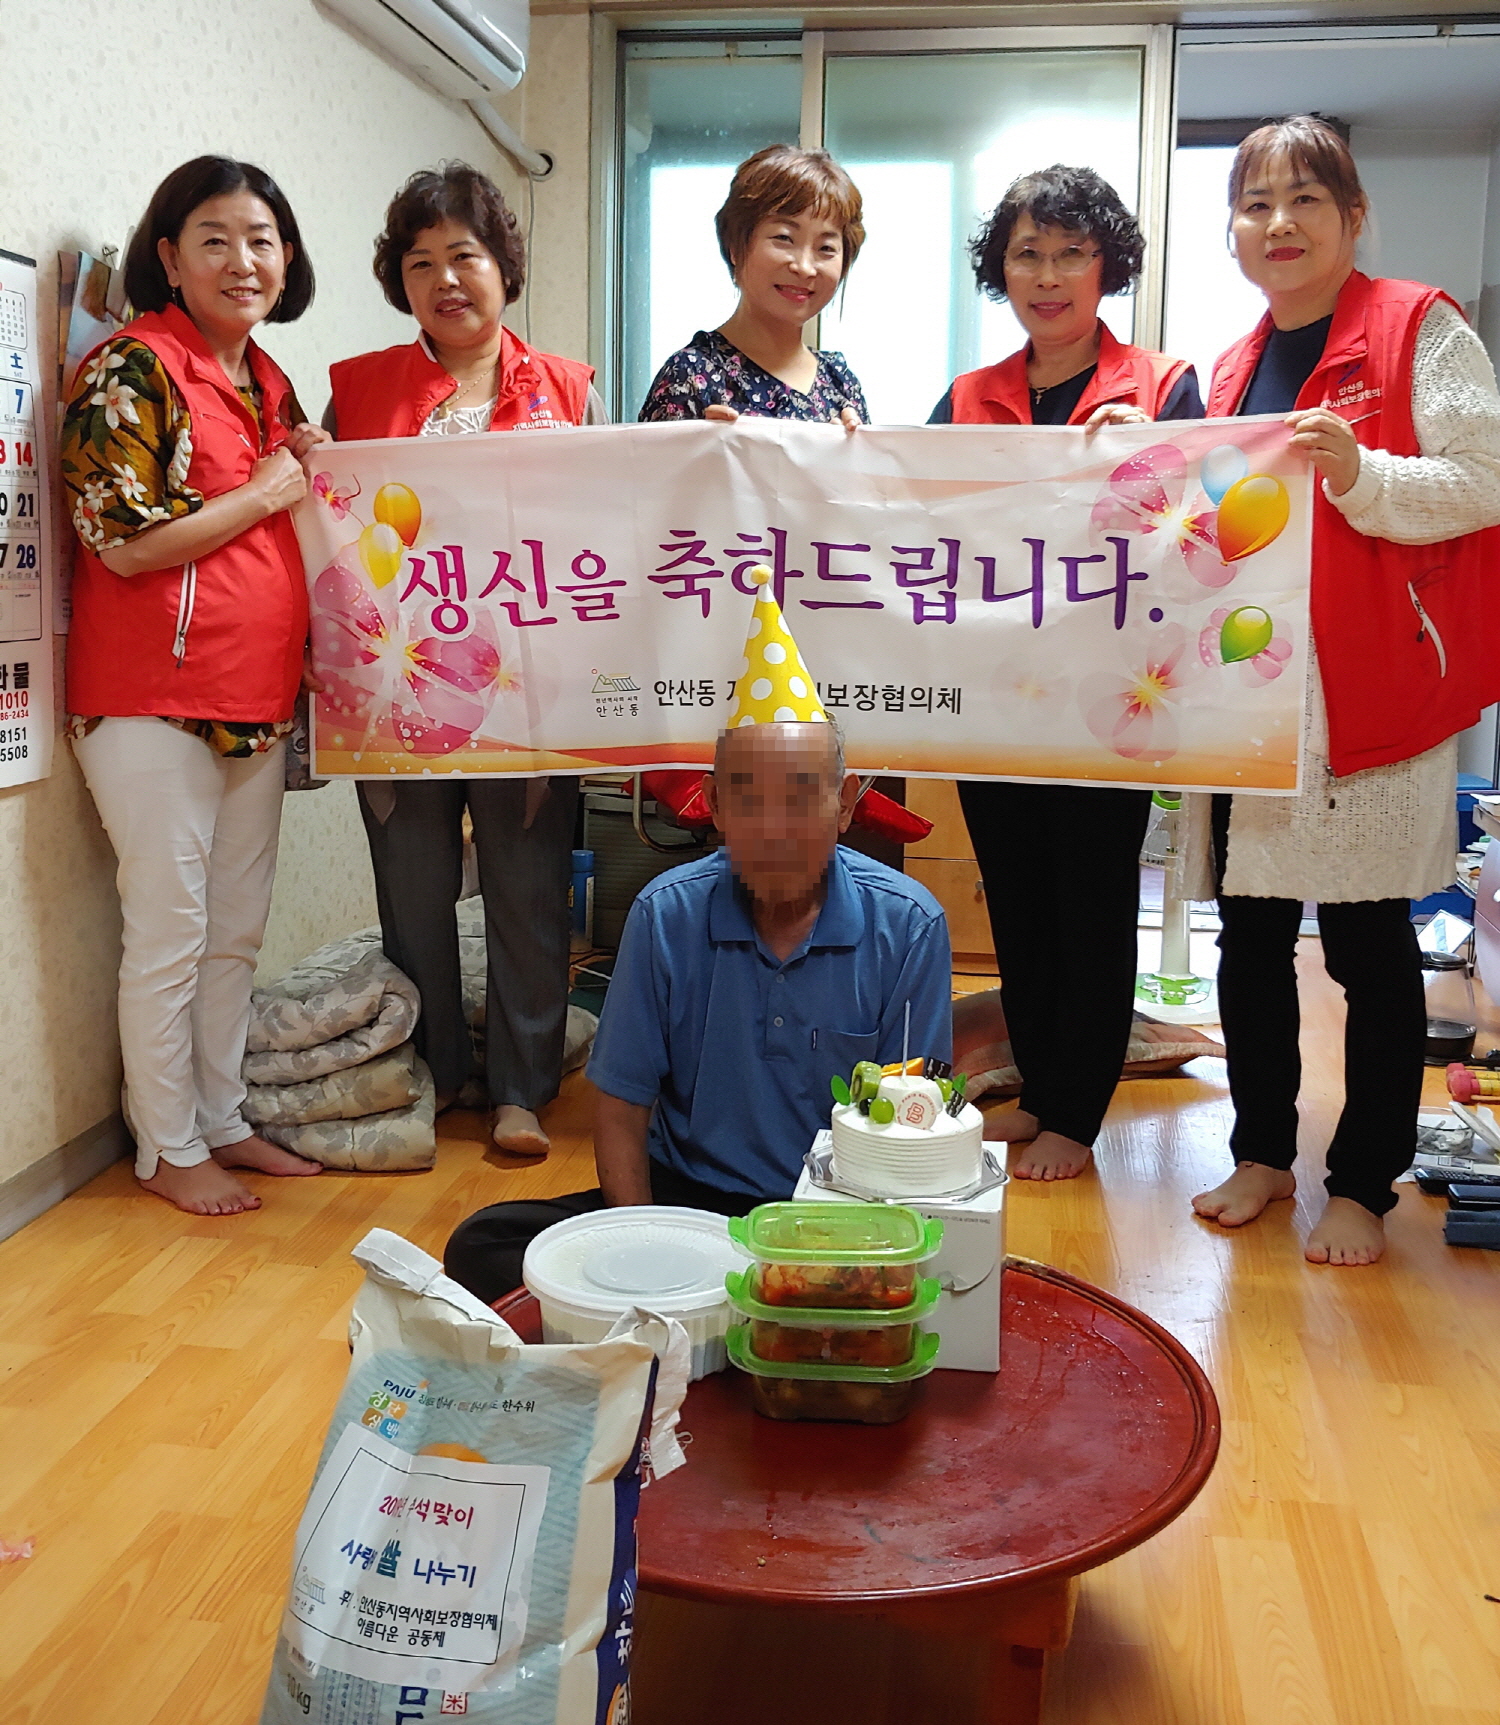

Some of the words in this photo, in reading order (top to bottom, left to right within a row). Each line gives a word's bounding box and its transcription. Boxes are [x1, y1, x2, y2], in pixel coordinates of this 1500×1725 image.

[10, 353, 23, 370] 土
[1337, 380, 1364, 396] 안산동
[15, 389, 24, 414] 7
[15, 441, 33, 467] 14
[17, 492, 34, 517] 21
[16, 544, 36, 569] 28
[400, 539, 627, 636] 생신을
[647, 527, 1165, 632] 축하드립니다.
[653, 679, 716, 707] 안산동
[726, 680, 963, 715] 보장협의체
[595, 703, 640, 718] 안산동
[0, 726, 27, 744] 8151
[0, 745, 28, 763] 5508
[501, 1399, 536, 1414] 한수위
[413, 1557, 477, 1589] 나누기
[357, 1617, 400, 1644] 아름다운
